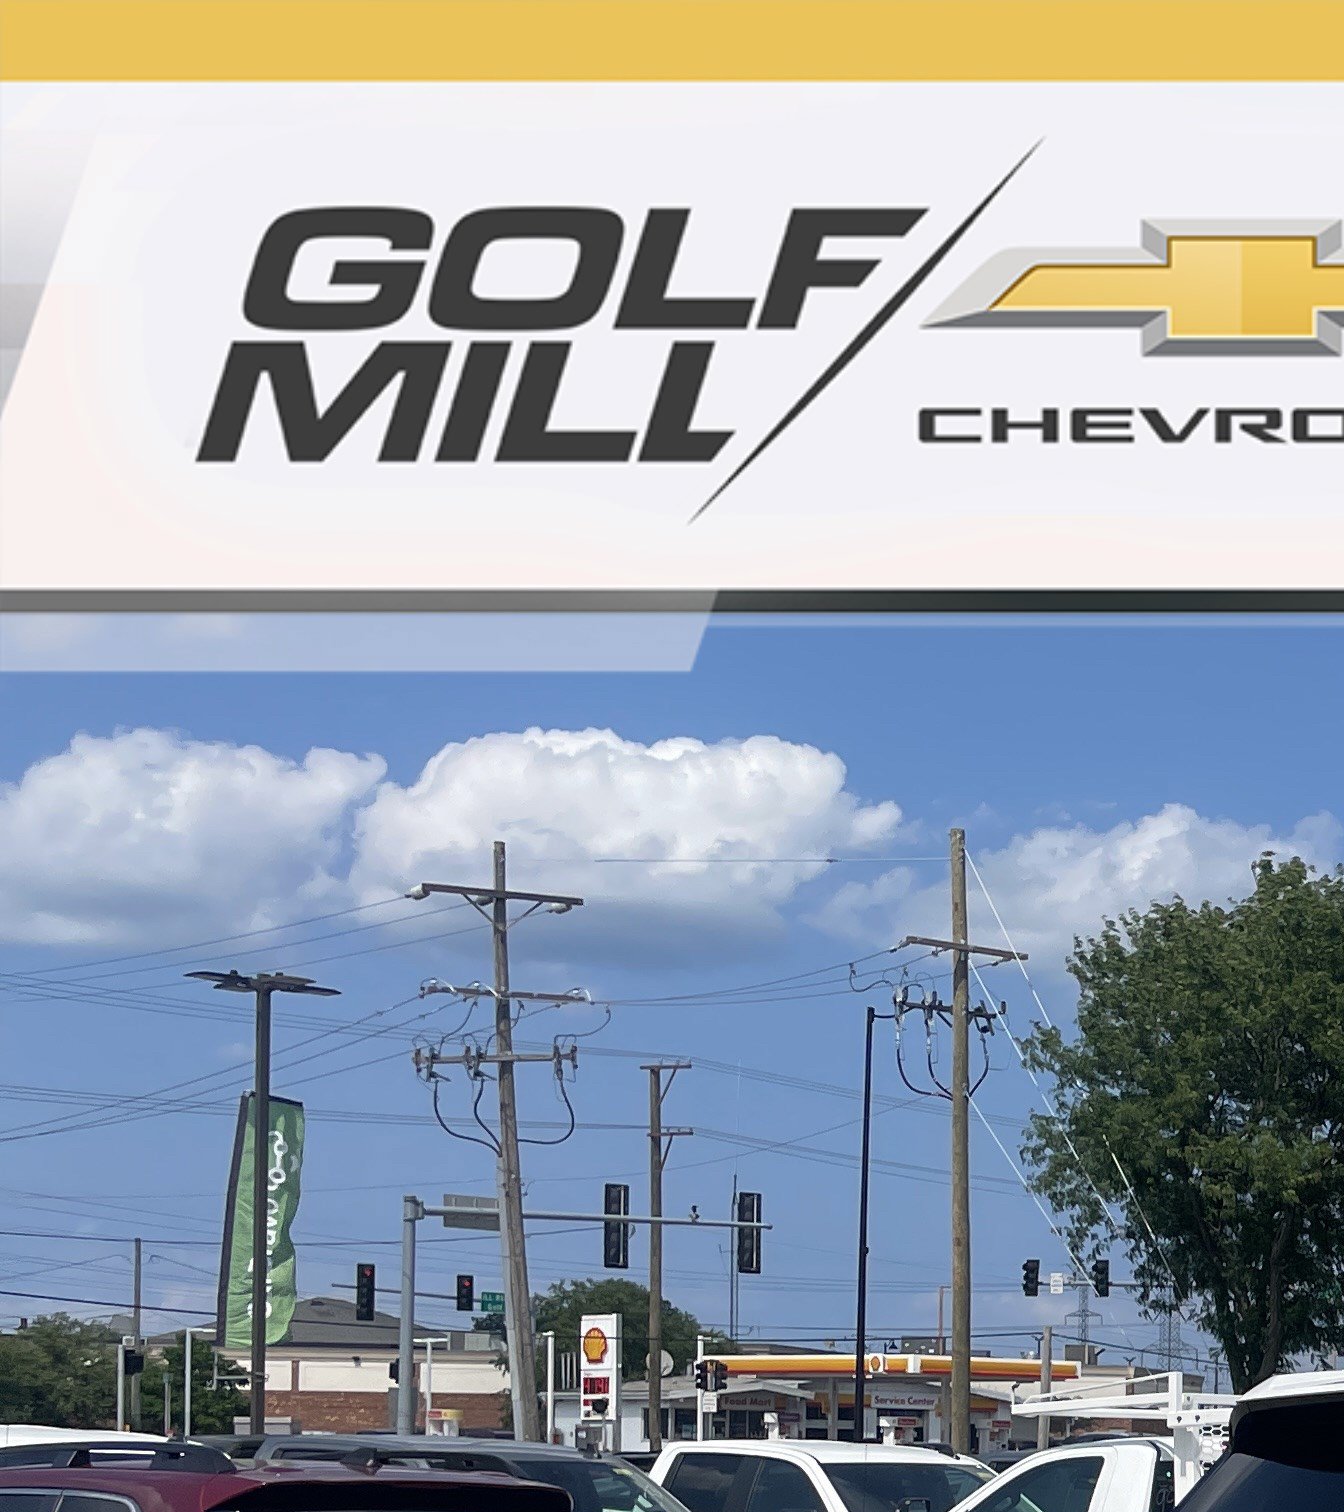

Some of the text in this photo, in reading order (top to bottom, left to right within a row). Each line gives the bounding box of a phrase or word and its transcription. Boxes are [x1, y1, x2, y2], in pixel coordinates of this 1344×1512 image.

[725, 1397, 747, 1406] Food
[750, 1397, 771, 1406] Mart
[875, 1395, 934, 1405] Service Center
